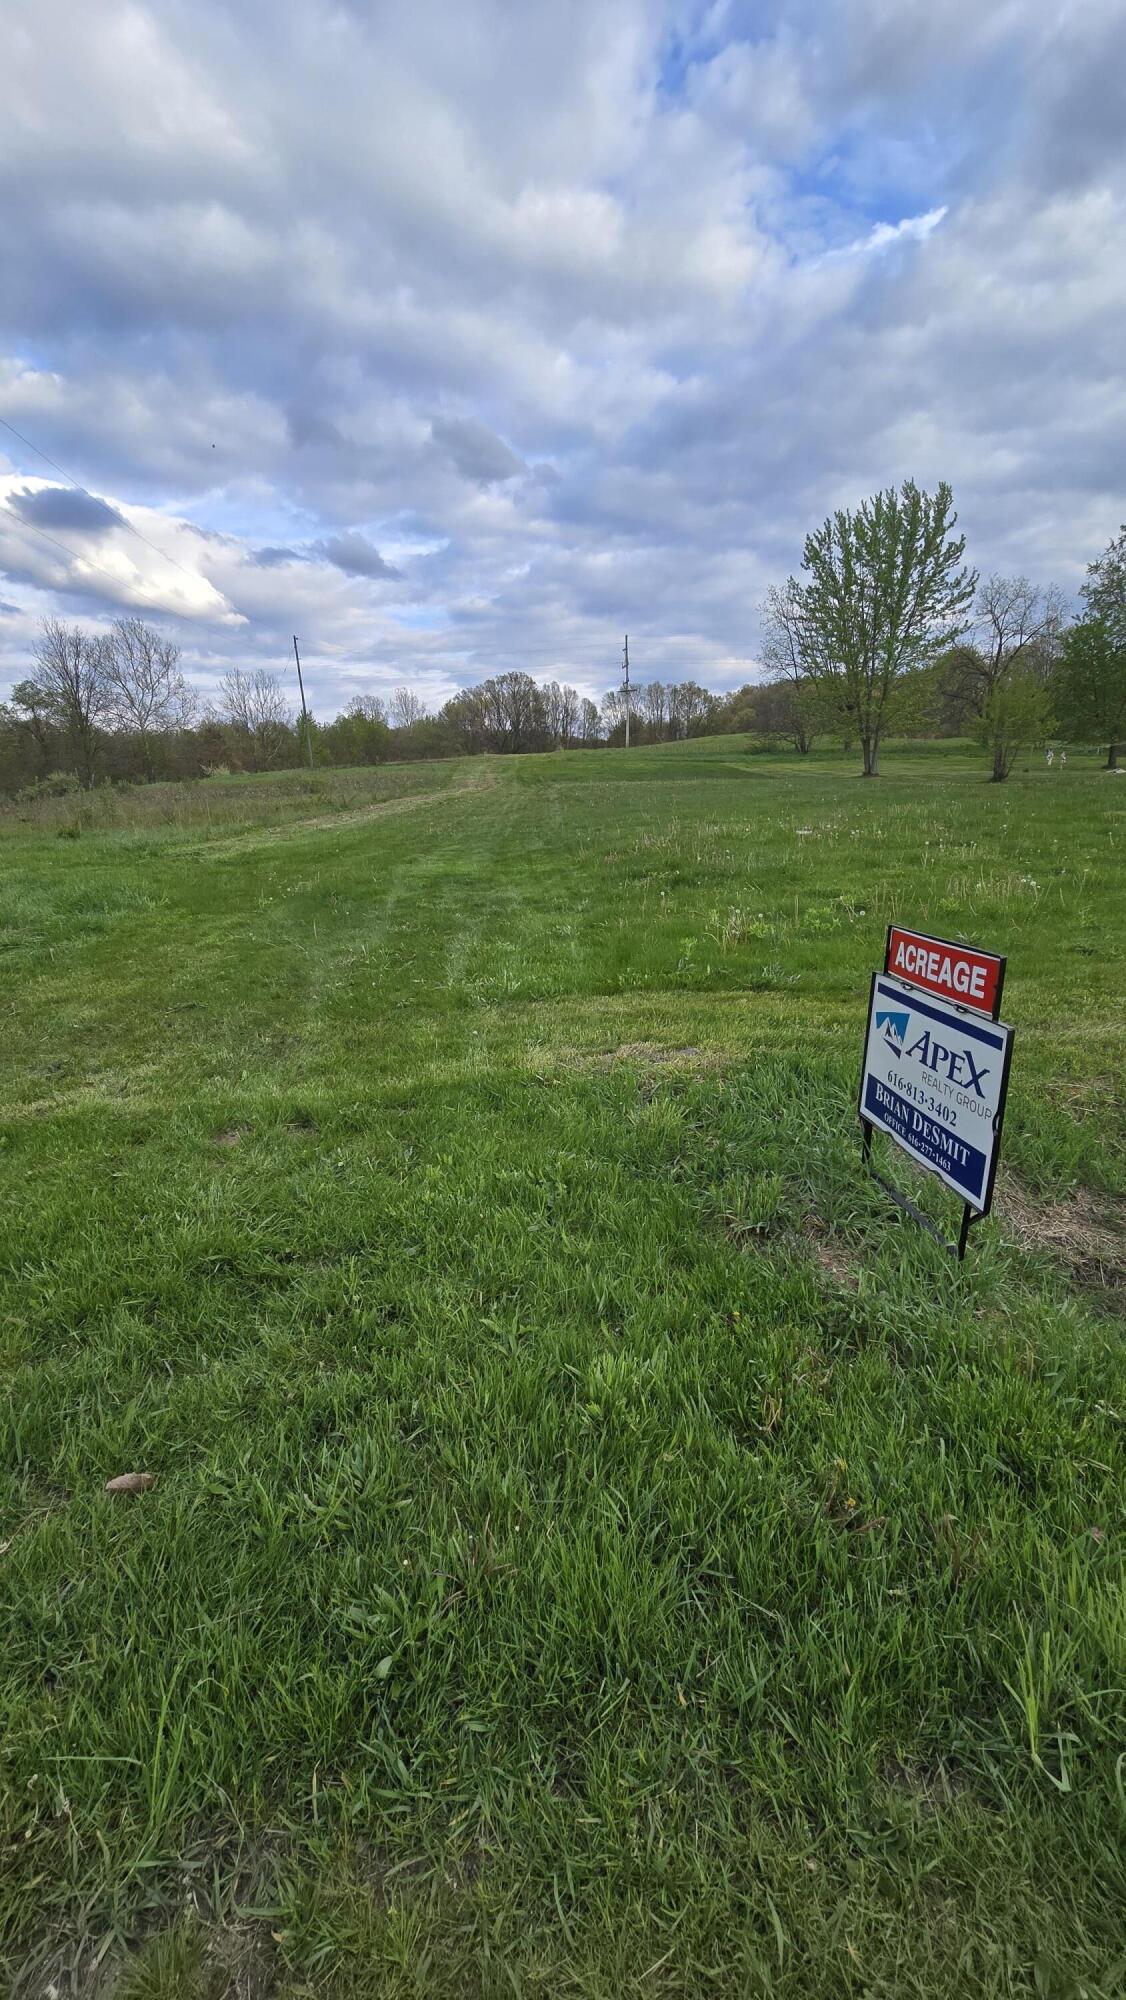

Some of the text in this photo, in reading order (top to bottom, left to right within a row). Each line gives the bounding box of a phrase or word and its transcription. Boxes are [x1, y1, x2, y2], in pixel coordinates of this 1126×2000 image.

[894, 941, 988, 999] ACREAGE
[905, 1030, 991, 1100] APEX
[884, 1112, 906, 1137] OFFICE
[921, 1071, 993, 1120] REALTY GROUP
[875, 1083, 971, 1167] BRIAN DESMIT
